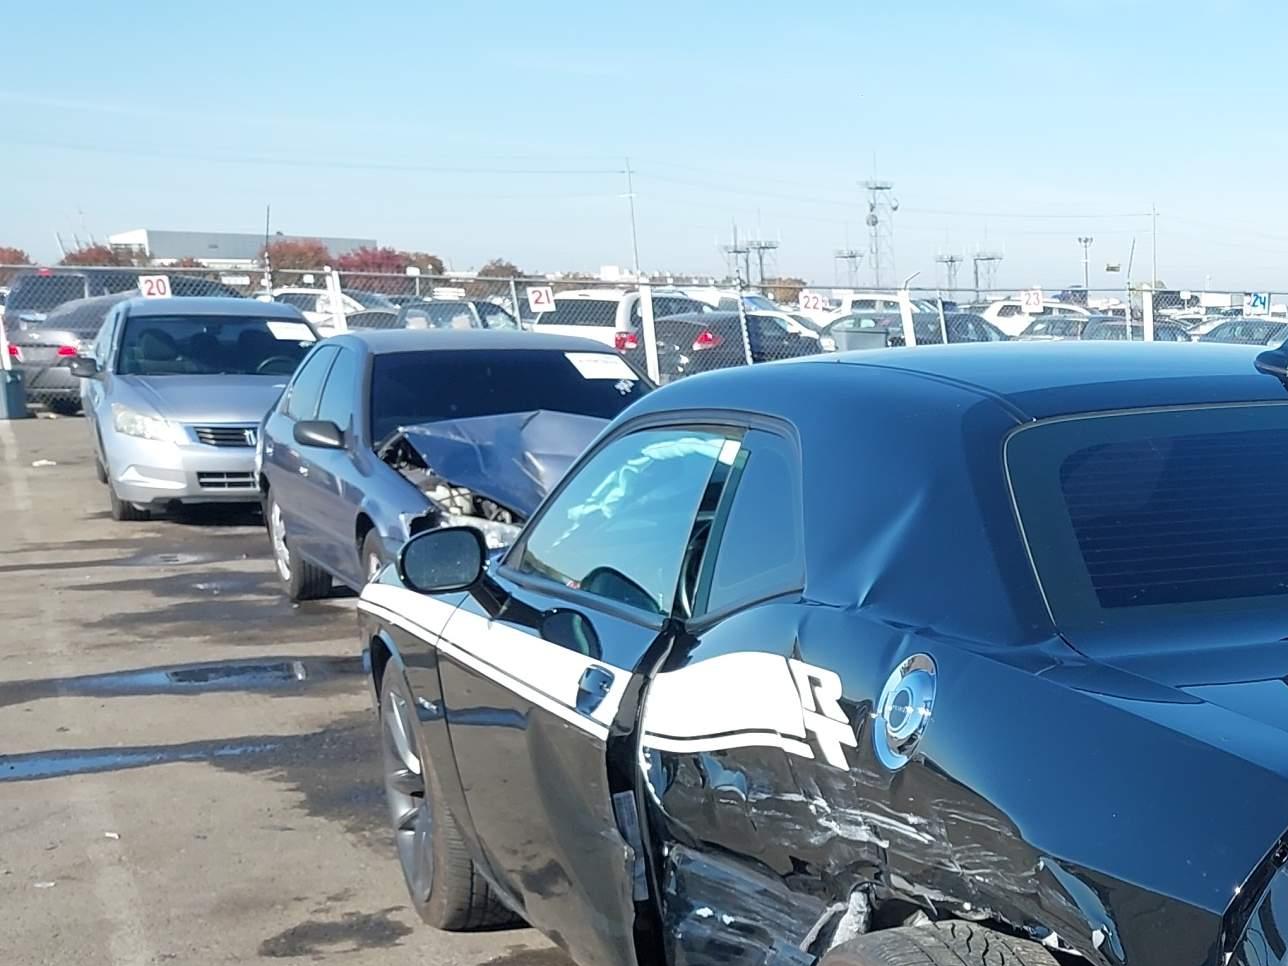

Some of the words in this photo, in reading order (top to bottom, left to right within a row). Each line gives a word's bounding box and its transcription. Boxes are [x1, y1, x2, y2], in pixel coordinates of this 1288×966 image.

[144, 278, 167, 297] 20
[531, 289, 551, 305] 21
[803, 295, 820, 310] 22
[1023, 292, 1041, 306] 23
[1251, 293, 1267, 310] 24
